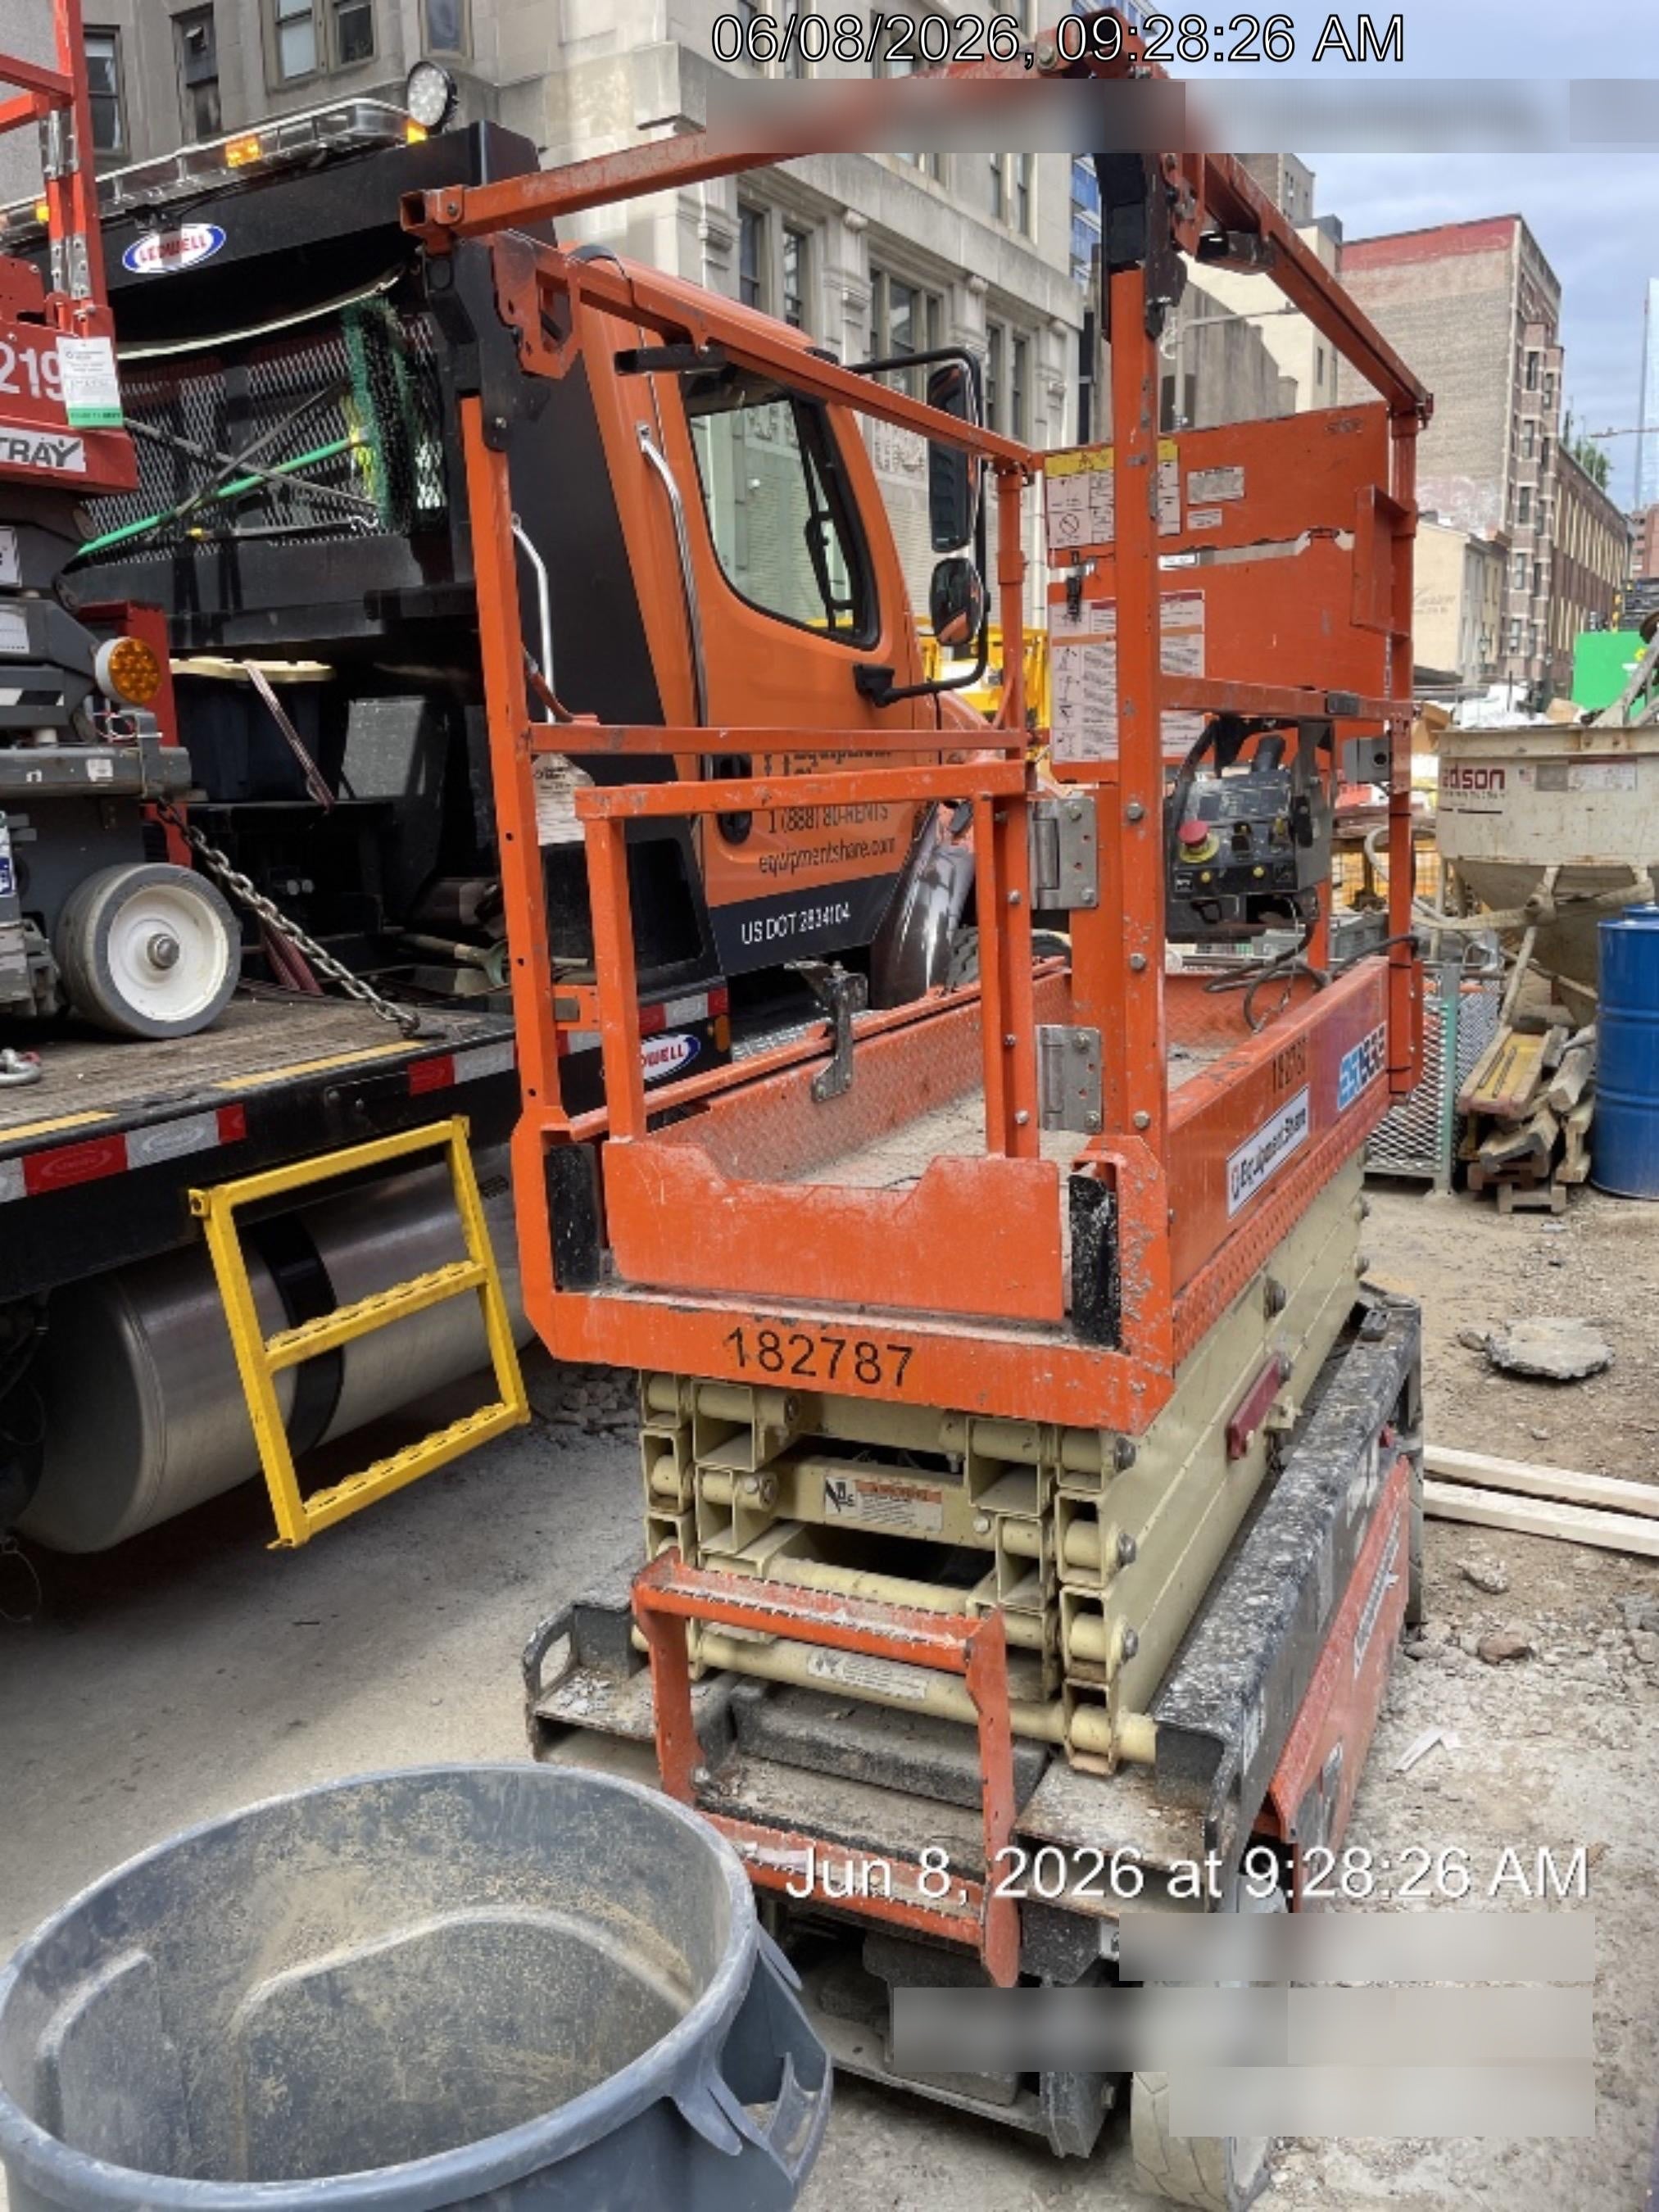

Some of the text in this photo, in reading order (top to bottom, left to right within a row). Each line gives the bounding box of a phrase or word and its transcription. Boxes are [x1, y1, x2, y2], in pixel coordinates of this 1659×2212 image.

[139, 234, 206, 261] LEDWELL
[0, 437, 82, 467] RAY
[759, 837, 895, 876] equipmentshare.com
[741, 918, 764, 945] US
[765, 911, 797, 941] DOT
[723, 1326, 915, 1388] 182787
